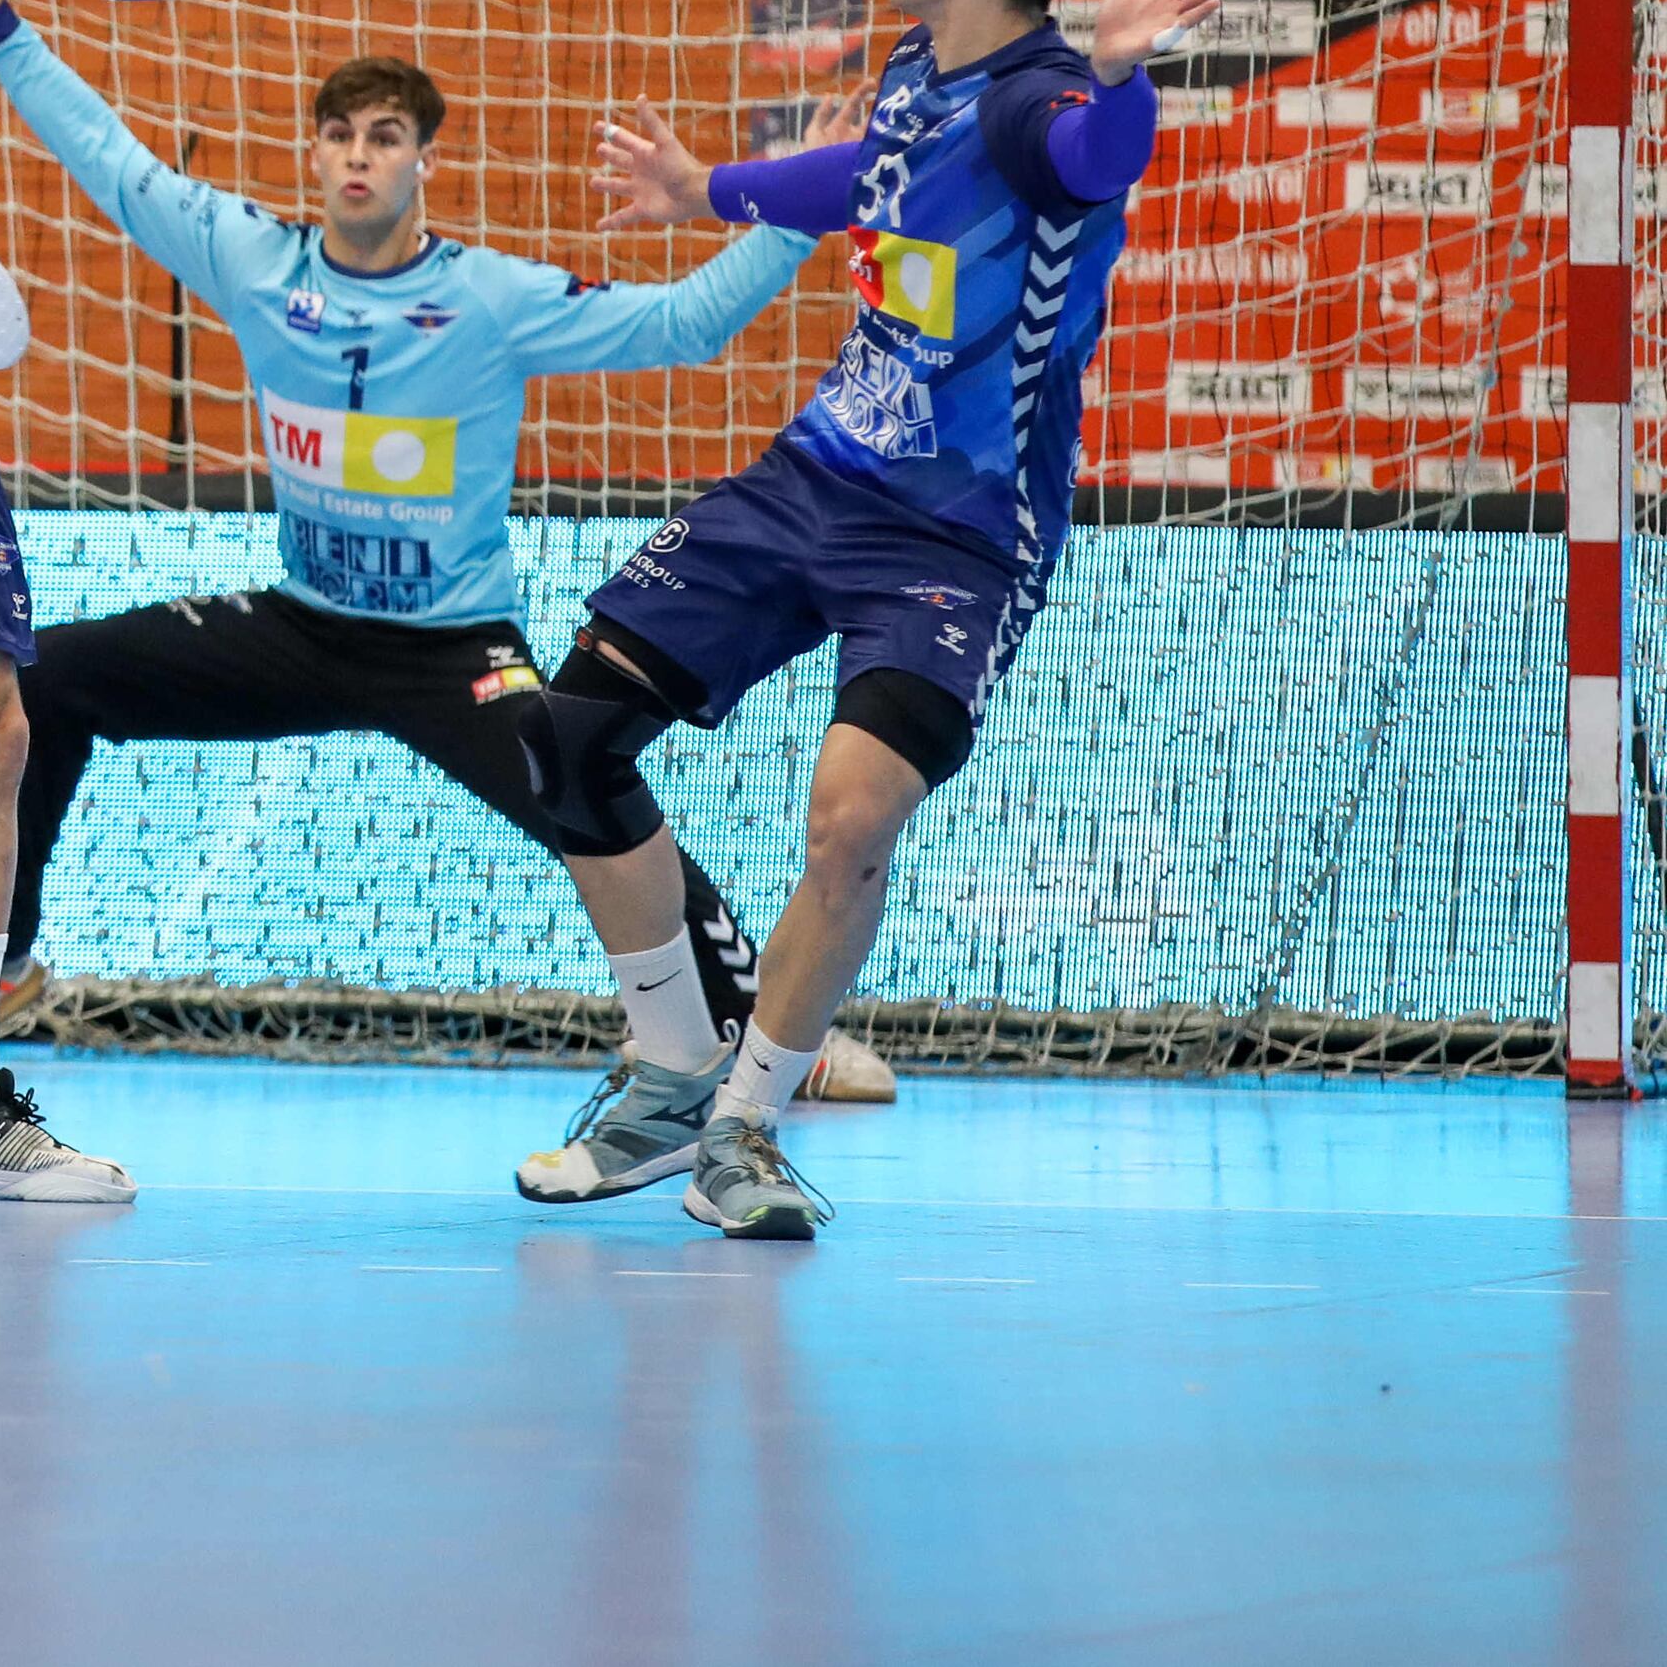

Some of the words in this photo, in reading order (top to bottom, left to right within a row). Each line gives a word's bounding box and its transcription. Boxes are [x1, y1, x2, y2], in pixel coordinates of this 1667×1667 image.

[341, 346, 371, 411] 1
[270, 413, 322, 468] TM
[323, 492, 384, 519] Estate
[389, 500, 454, 525] Group
